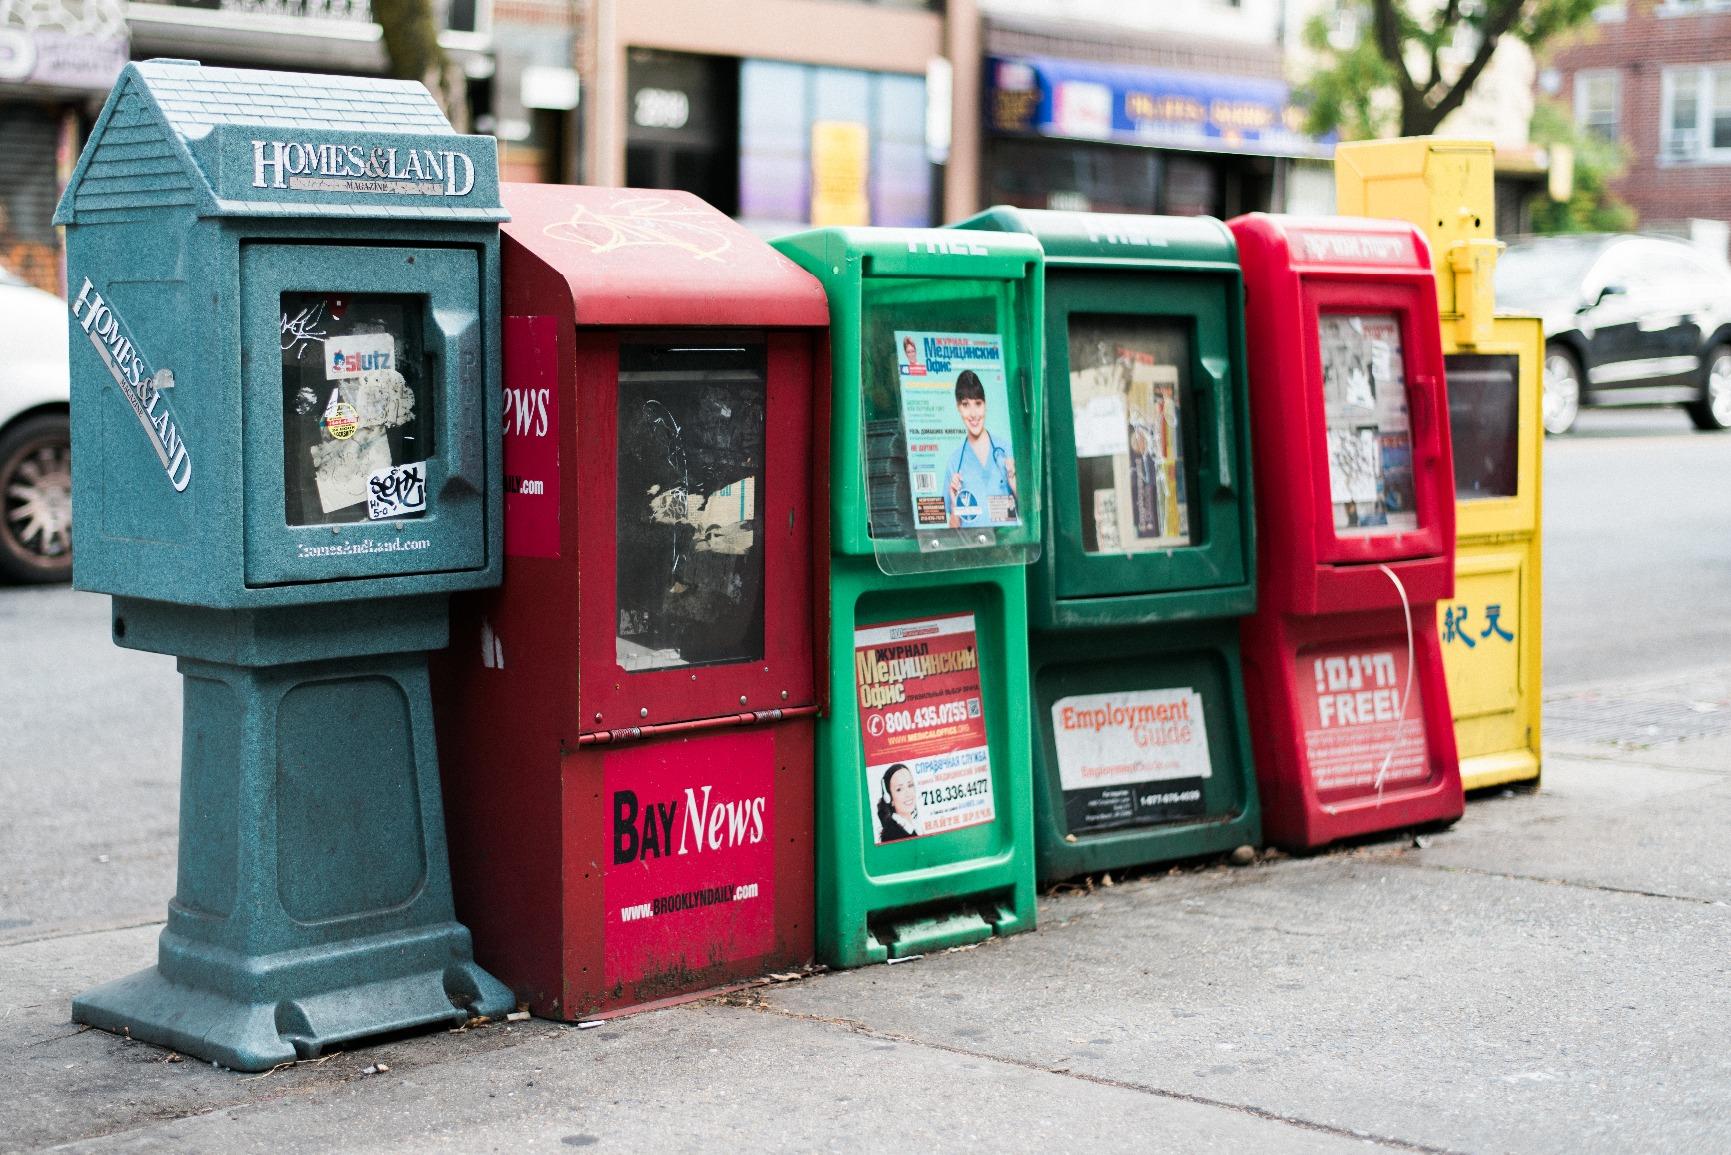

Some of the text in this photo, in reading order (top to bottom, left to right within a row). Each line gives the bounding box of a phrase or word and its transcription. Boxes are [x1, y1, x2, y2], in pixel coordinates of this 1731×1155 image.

[345, 180, 388, 193] MAGAZINE
[923, 337, 1000, 360] Медицинский
[925, 358, 952, 375] Офис
[119, 377, 144, 419] MAGAZINE
[855, 646, 977, 686] Медицинский
[877, 643, 929, 661] ЖУРНАЛ
[860, 683, 907, 710] Офис
[1317, 687, 1402, 729] FREE!
[884, 700, 968, 733] 800.435.0755
[1061, 697, 1191, 733] Employment
[1133, 721, 1193, 749] Guide
[920, 778, 988, 806] 718.336.4477
[613, 785, 766, 865] BAY News
[620, 882, 759, 923] www.BROOKLYNDAILY.com
